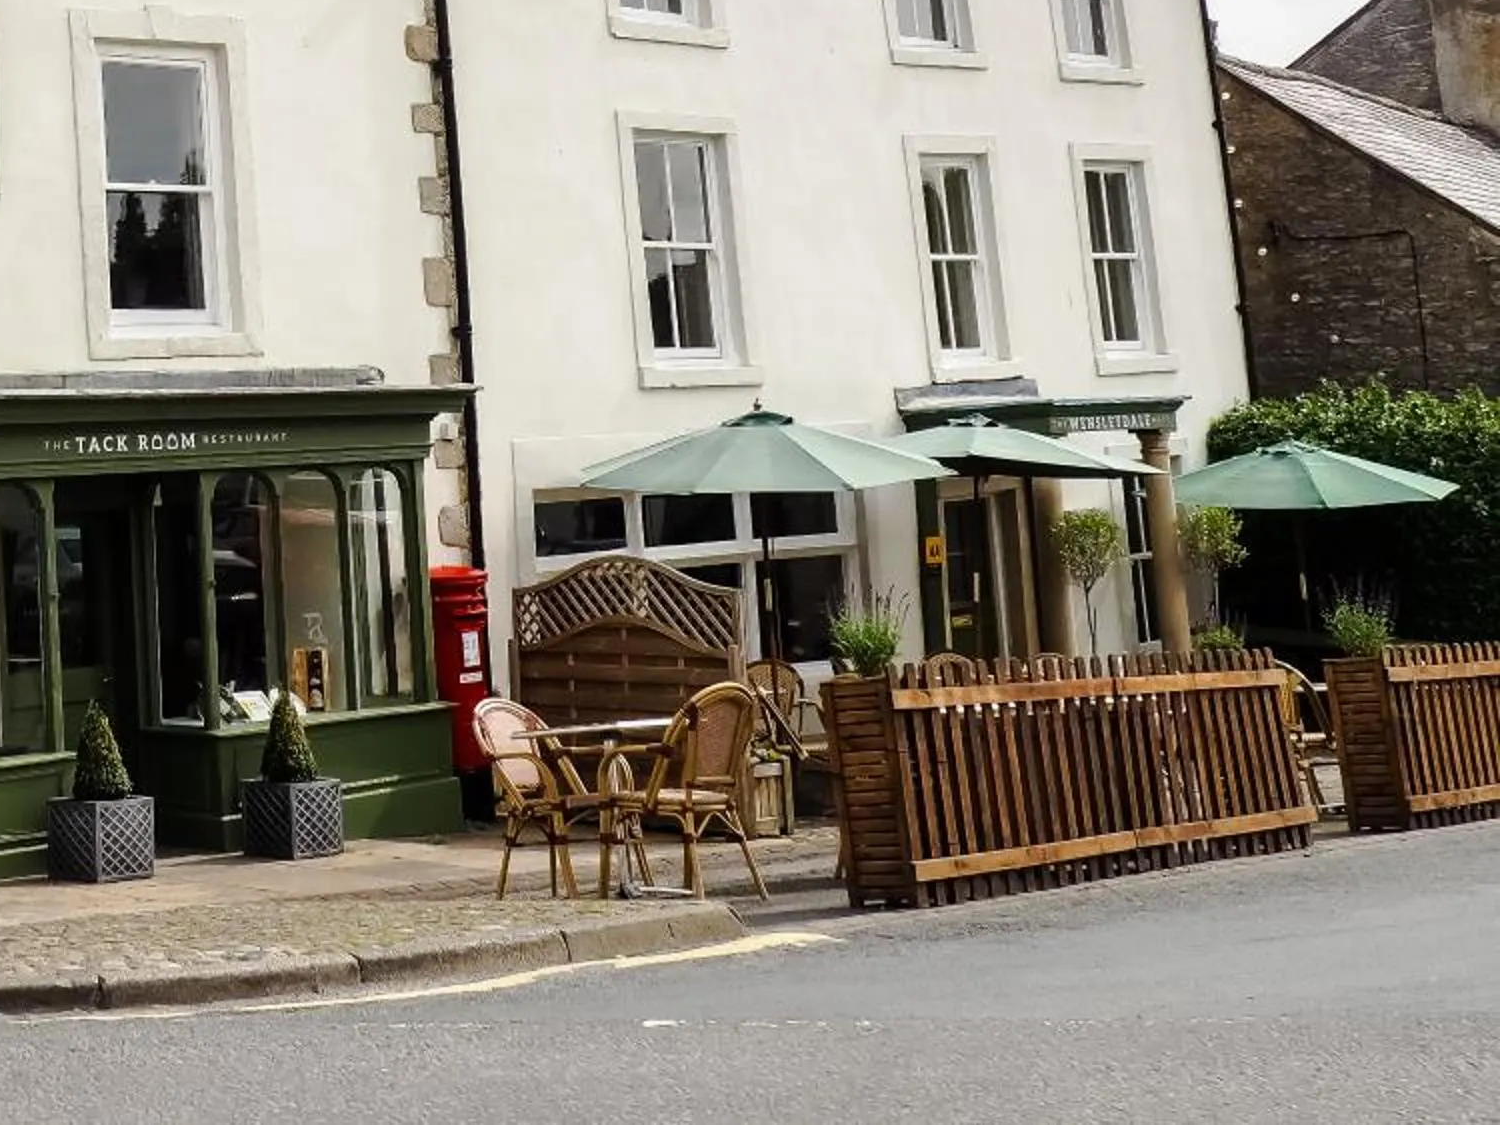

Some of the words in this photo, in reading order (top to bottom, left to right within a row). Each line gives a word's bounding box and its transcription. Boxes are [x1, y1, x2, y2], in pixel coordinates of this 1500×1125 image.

[43, 439, 71, 451] THE
[75, 435, 129, 453] TACK
[137, 432, 197, 451] ROOM
